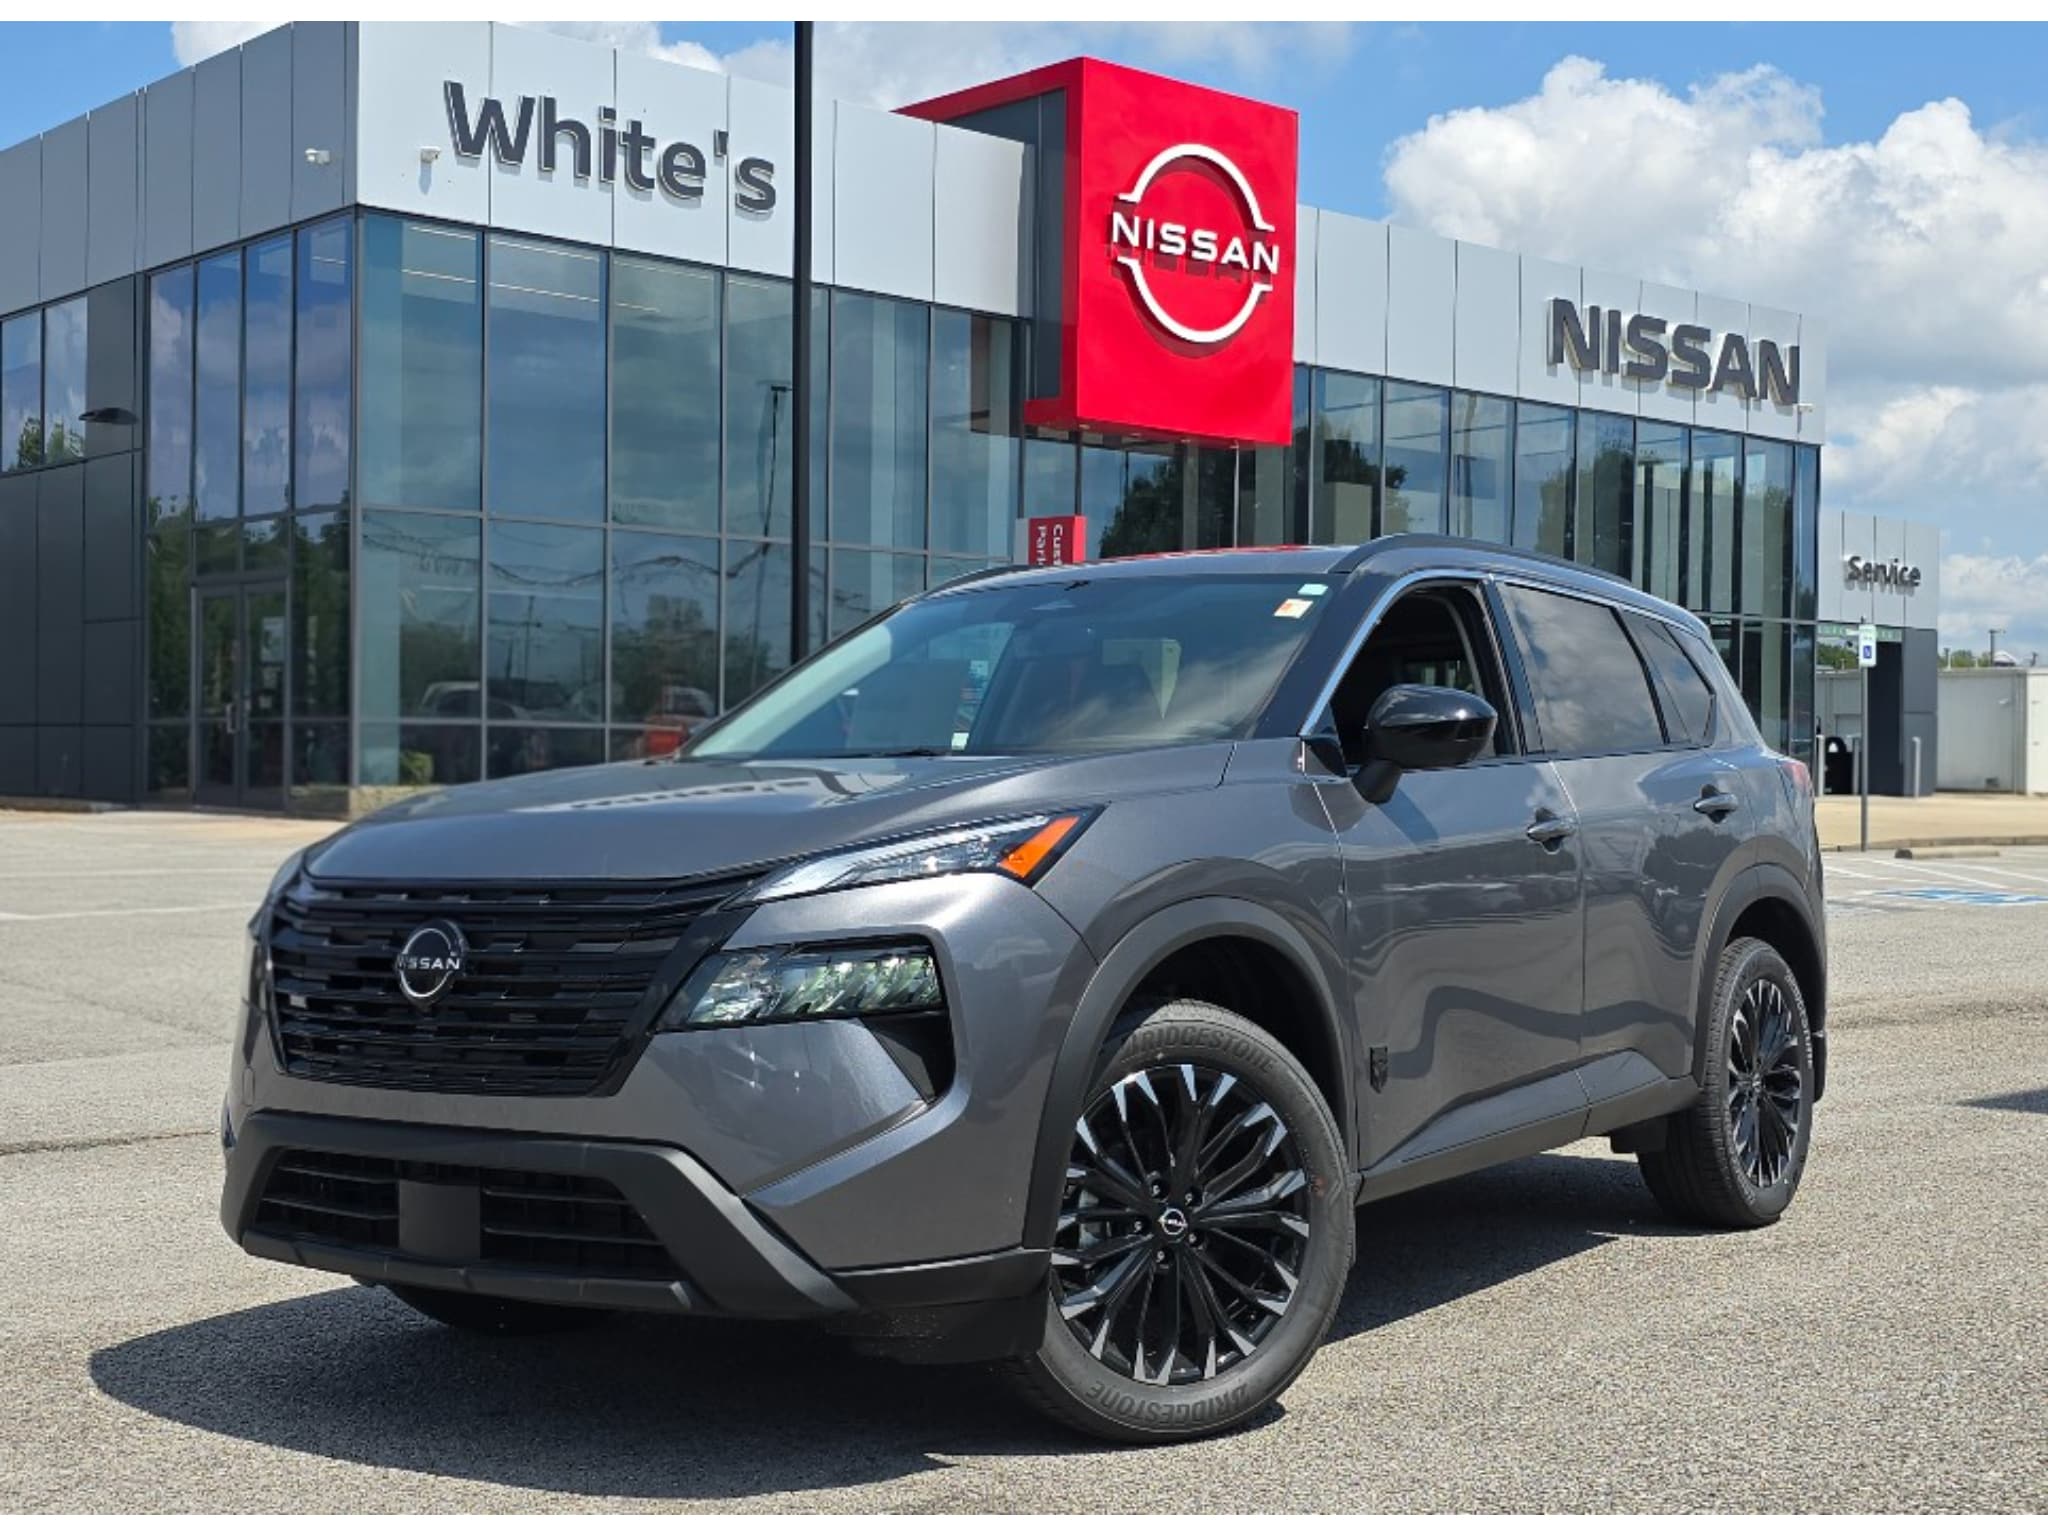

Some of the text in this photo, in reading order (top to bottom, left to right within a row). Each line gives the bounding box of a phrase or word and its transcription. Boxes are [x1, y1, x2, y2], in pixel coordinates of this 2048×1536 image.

[444, 80, 776, 214] White's
[1112, 211, 1279, 274] NISSAN
[1547, 297, 1801, 404] NISSAN
[1846, 555, 1921, 587] Service
[1085, 1380, 1248, 1426] BRIDGESTONE
